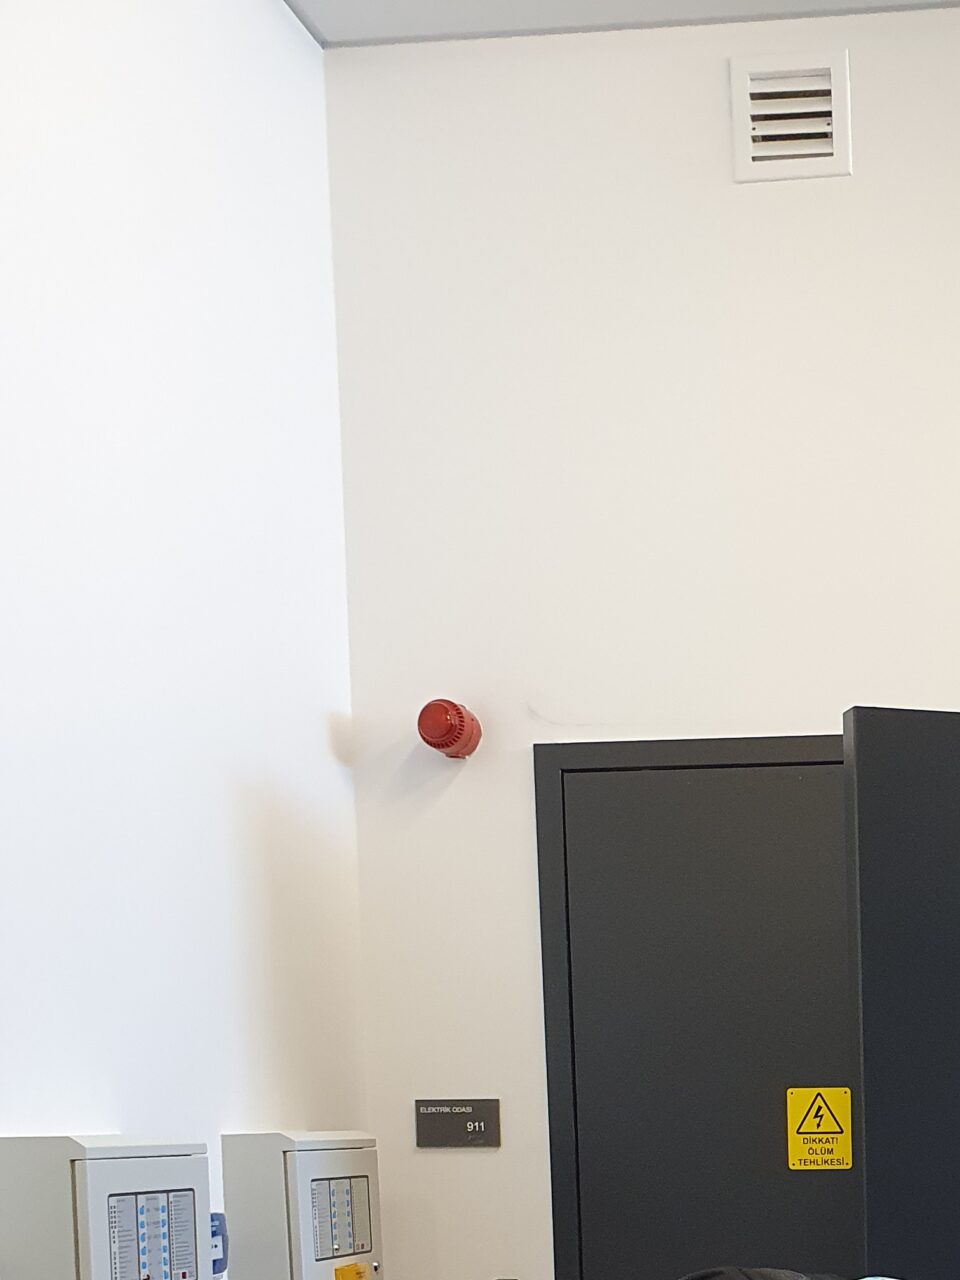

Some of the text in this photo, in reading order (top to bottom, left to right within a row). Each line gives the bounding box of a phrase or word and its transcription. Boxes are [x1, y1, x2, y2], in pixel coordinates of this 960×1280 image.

[466, 1121, 485, 1132] 911
[807, 1147, 834, 1156] ÖLÜM
[798, 1157, 845, 1167] TEHLİKESİ
